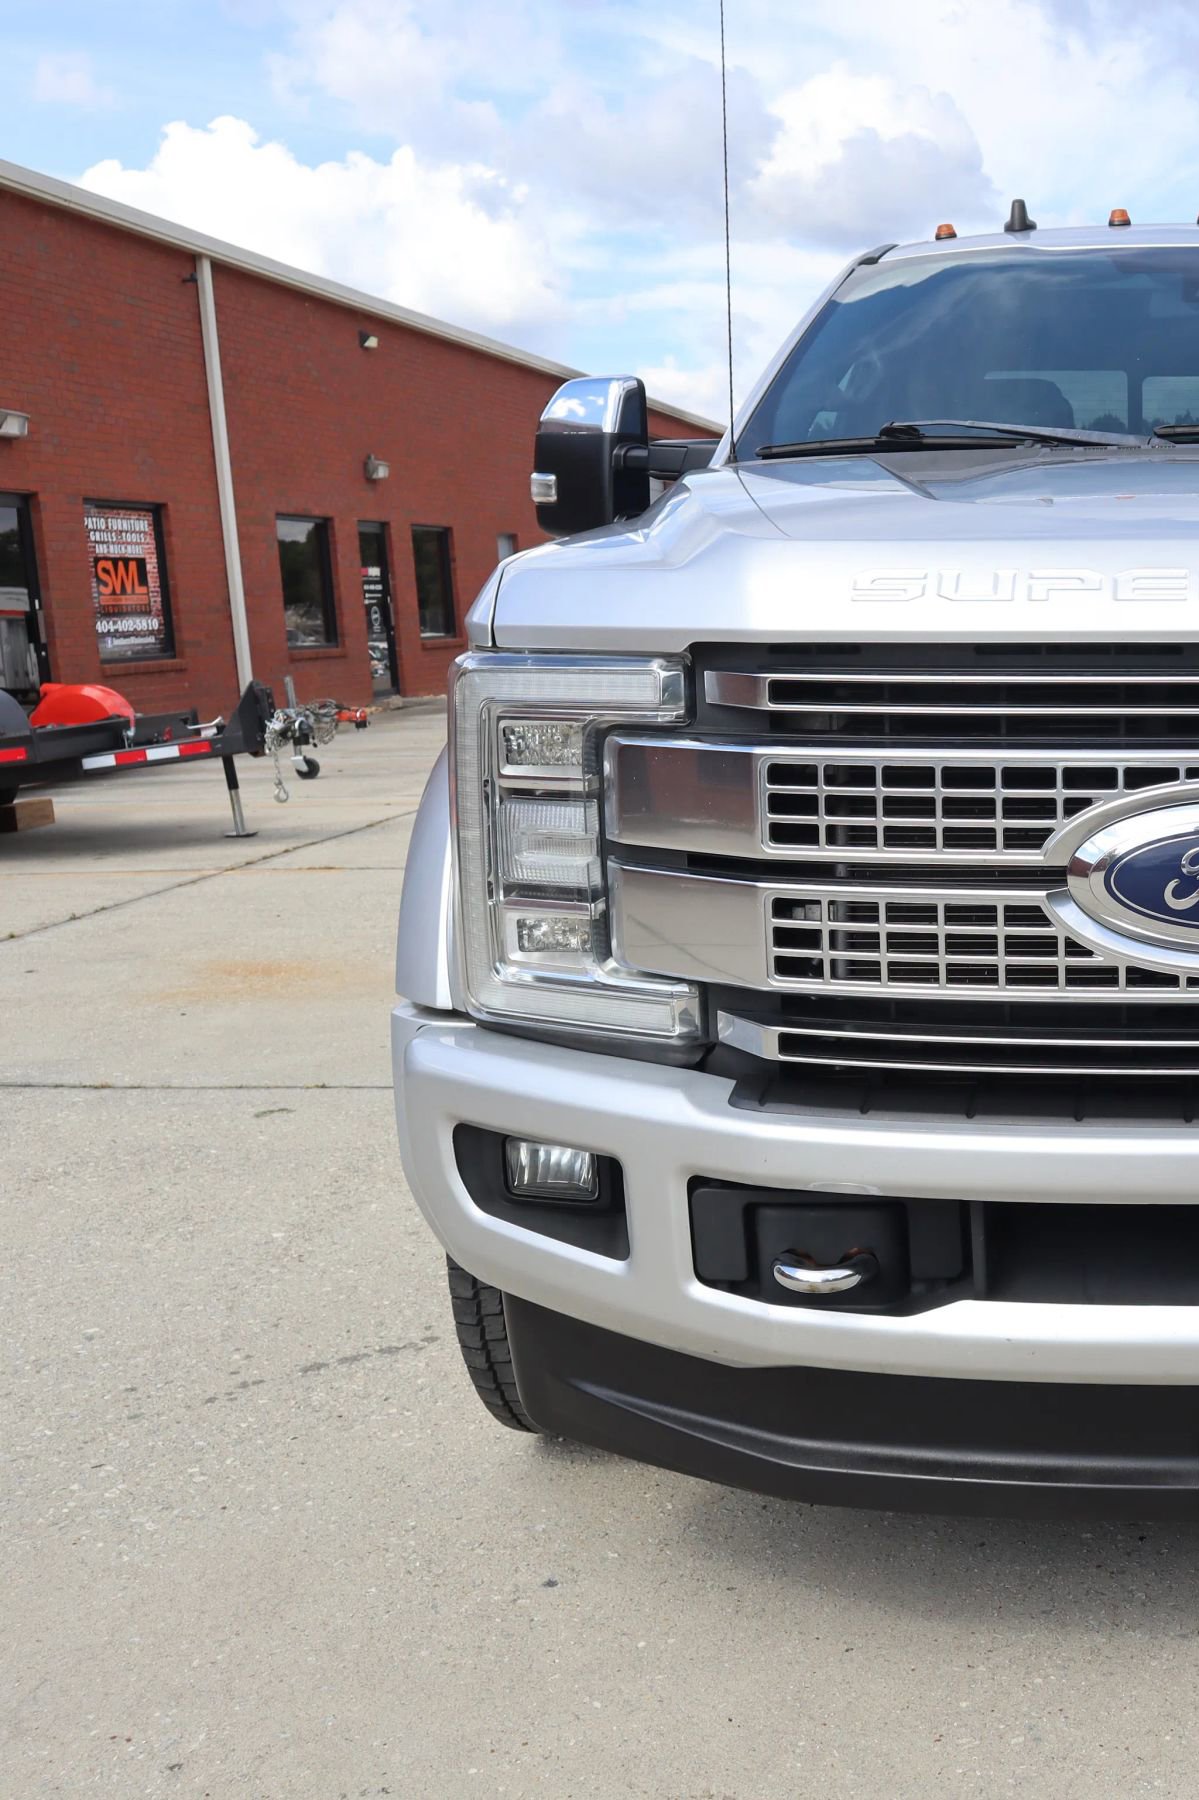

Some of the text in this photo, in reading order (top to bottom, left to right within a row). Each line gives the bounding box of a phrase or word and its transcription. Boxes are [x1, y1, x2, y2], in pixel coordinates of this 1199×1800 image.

[108, 518, 149, 532] FURNITURE
[89, 531, 117, 542] GRILLS
[122, 532, 145, 543] TOOLS
[96, 559, 148, 595] SWL
[96, 618, 159, 633] 404-402-5810
